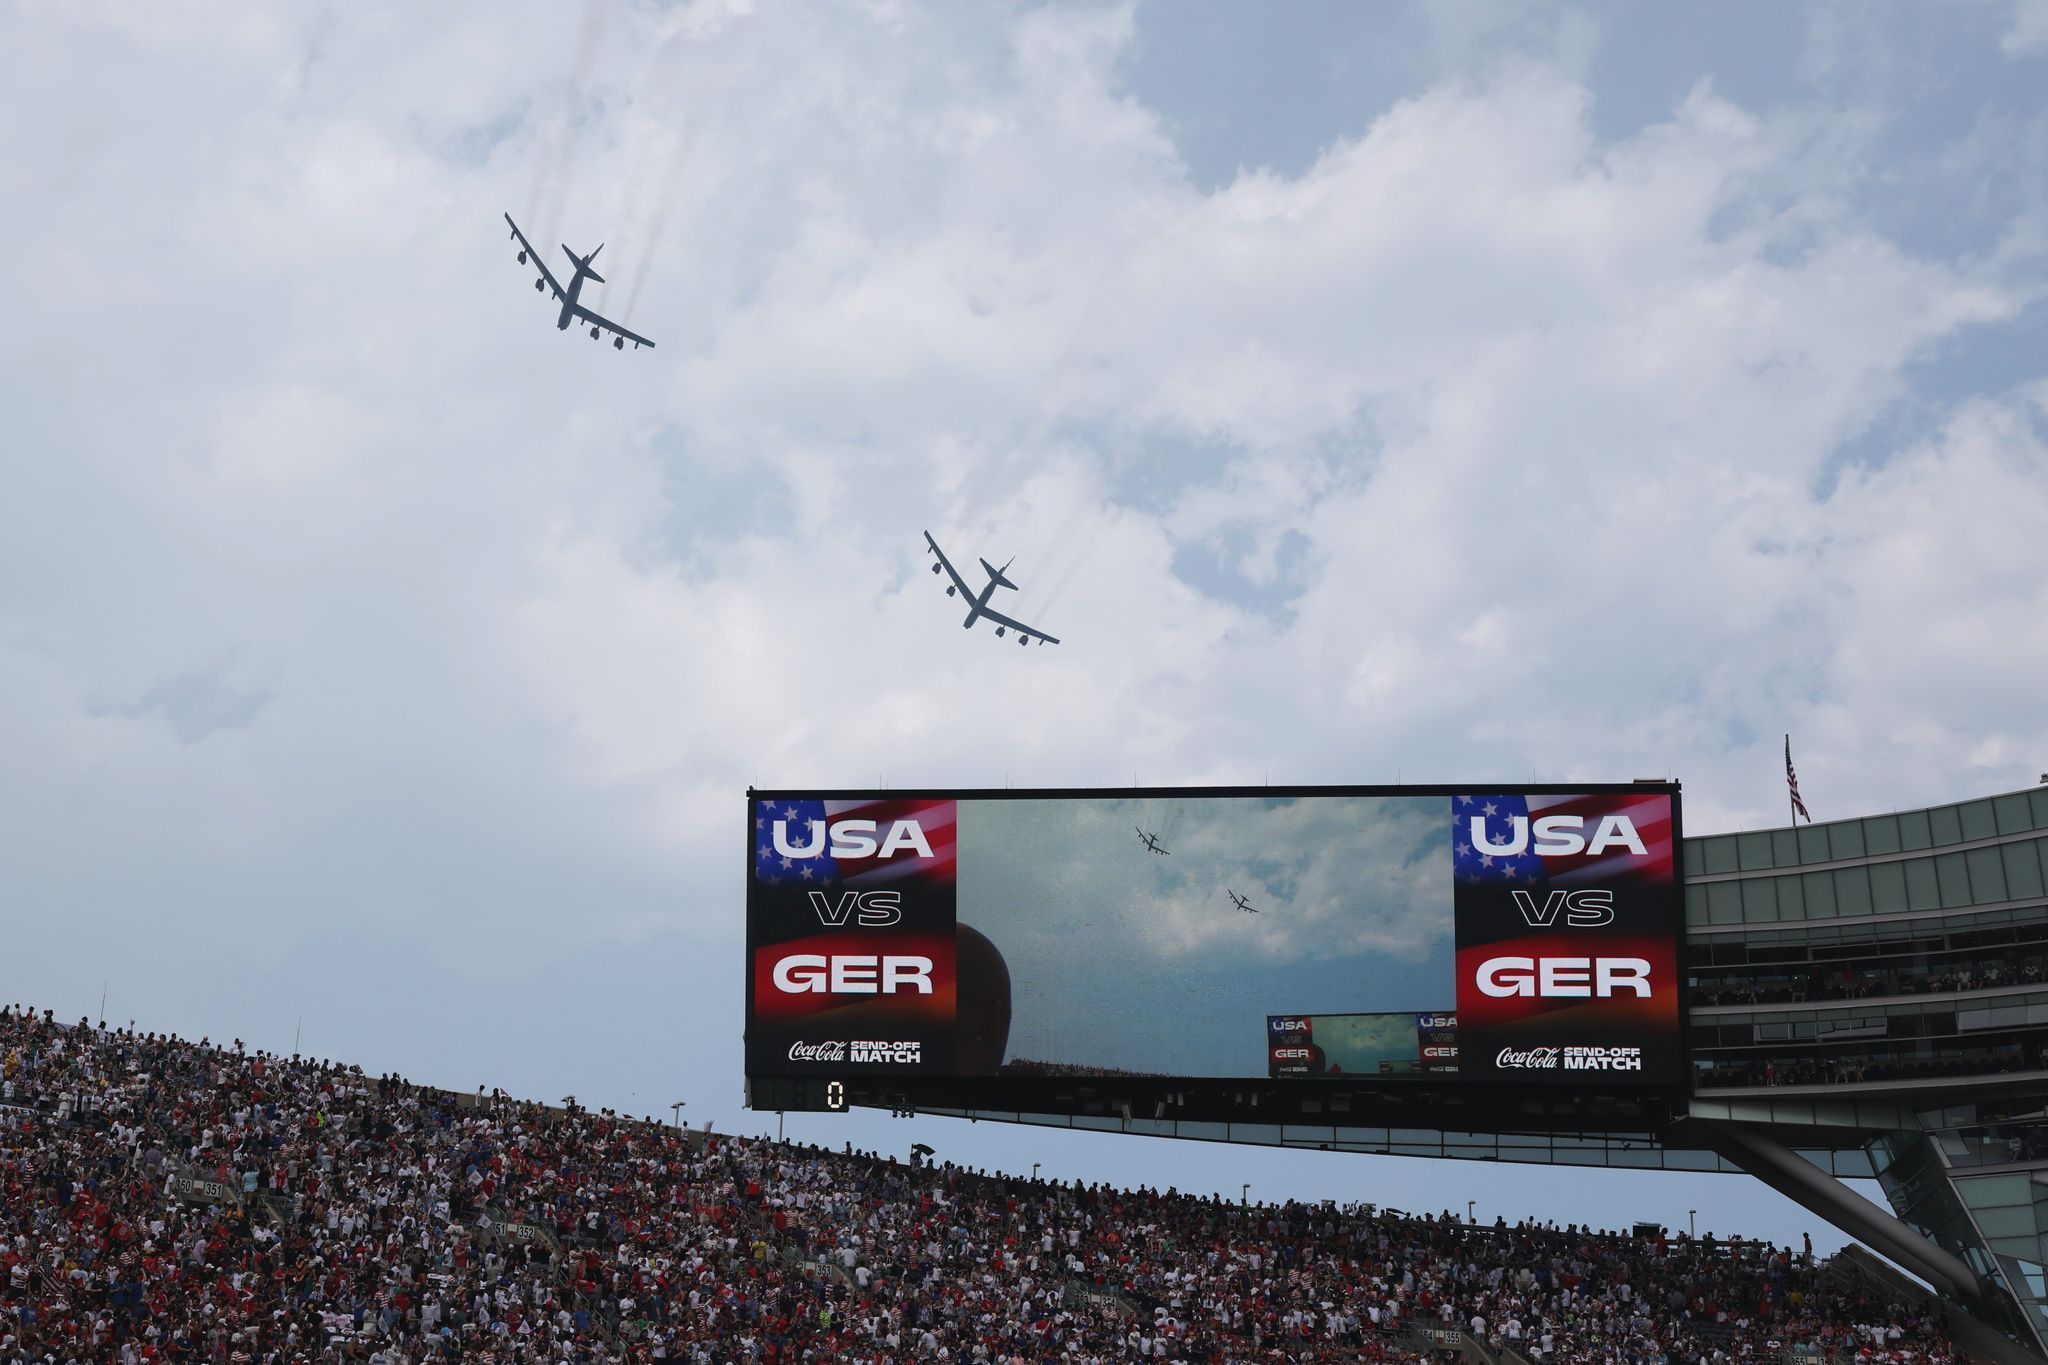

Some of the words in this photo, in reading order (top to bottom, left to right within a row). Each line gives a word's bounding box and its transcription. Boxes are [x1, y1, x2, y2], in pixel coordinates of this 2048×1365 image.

[772, 820, 934, 858] USA
[1470, 815, 1648, 856] USA
[808, 891, 902, 926] VS
[1511, 889, 1614, 927] VS
[772, 954, 933, 994] GER
[1475, 956, 1652, 998] GER
[1272, 1021, 1307, 1030] USA
[1420, 1017, 1458, 1027] USA
[788, 1040, 848, 1061] Coca-Cola
[850, 1040, 921, 1050] SEND-OFF
[1563, 1047, 1641, 1057] SEND-OFF
[850, 1050, 921, 1064] MATCH
[1274, 1049, 1309, 1058] GER
[1495, 1046, 1561, 1069] Coca-Cola
[1563, 1056, 1642, 1071] MATCH
[827, 1081, 844, 1109] 0
[205, 1183, 222, 1196] 351
[519, 1226, 534, 1239] 352
[817, 1264, 831, 1276] 353
[1446, 1332, 1460, 1343] 355
